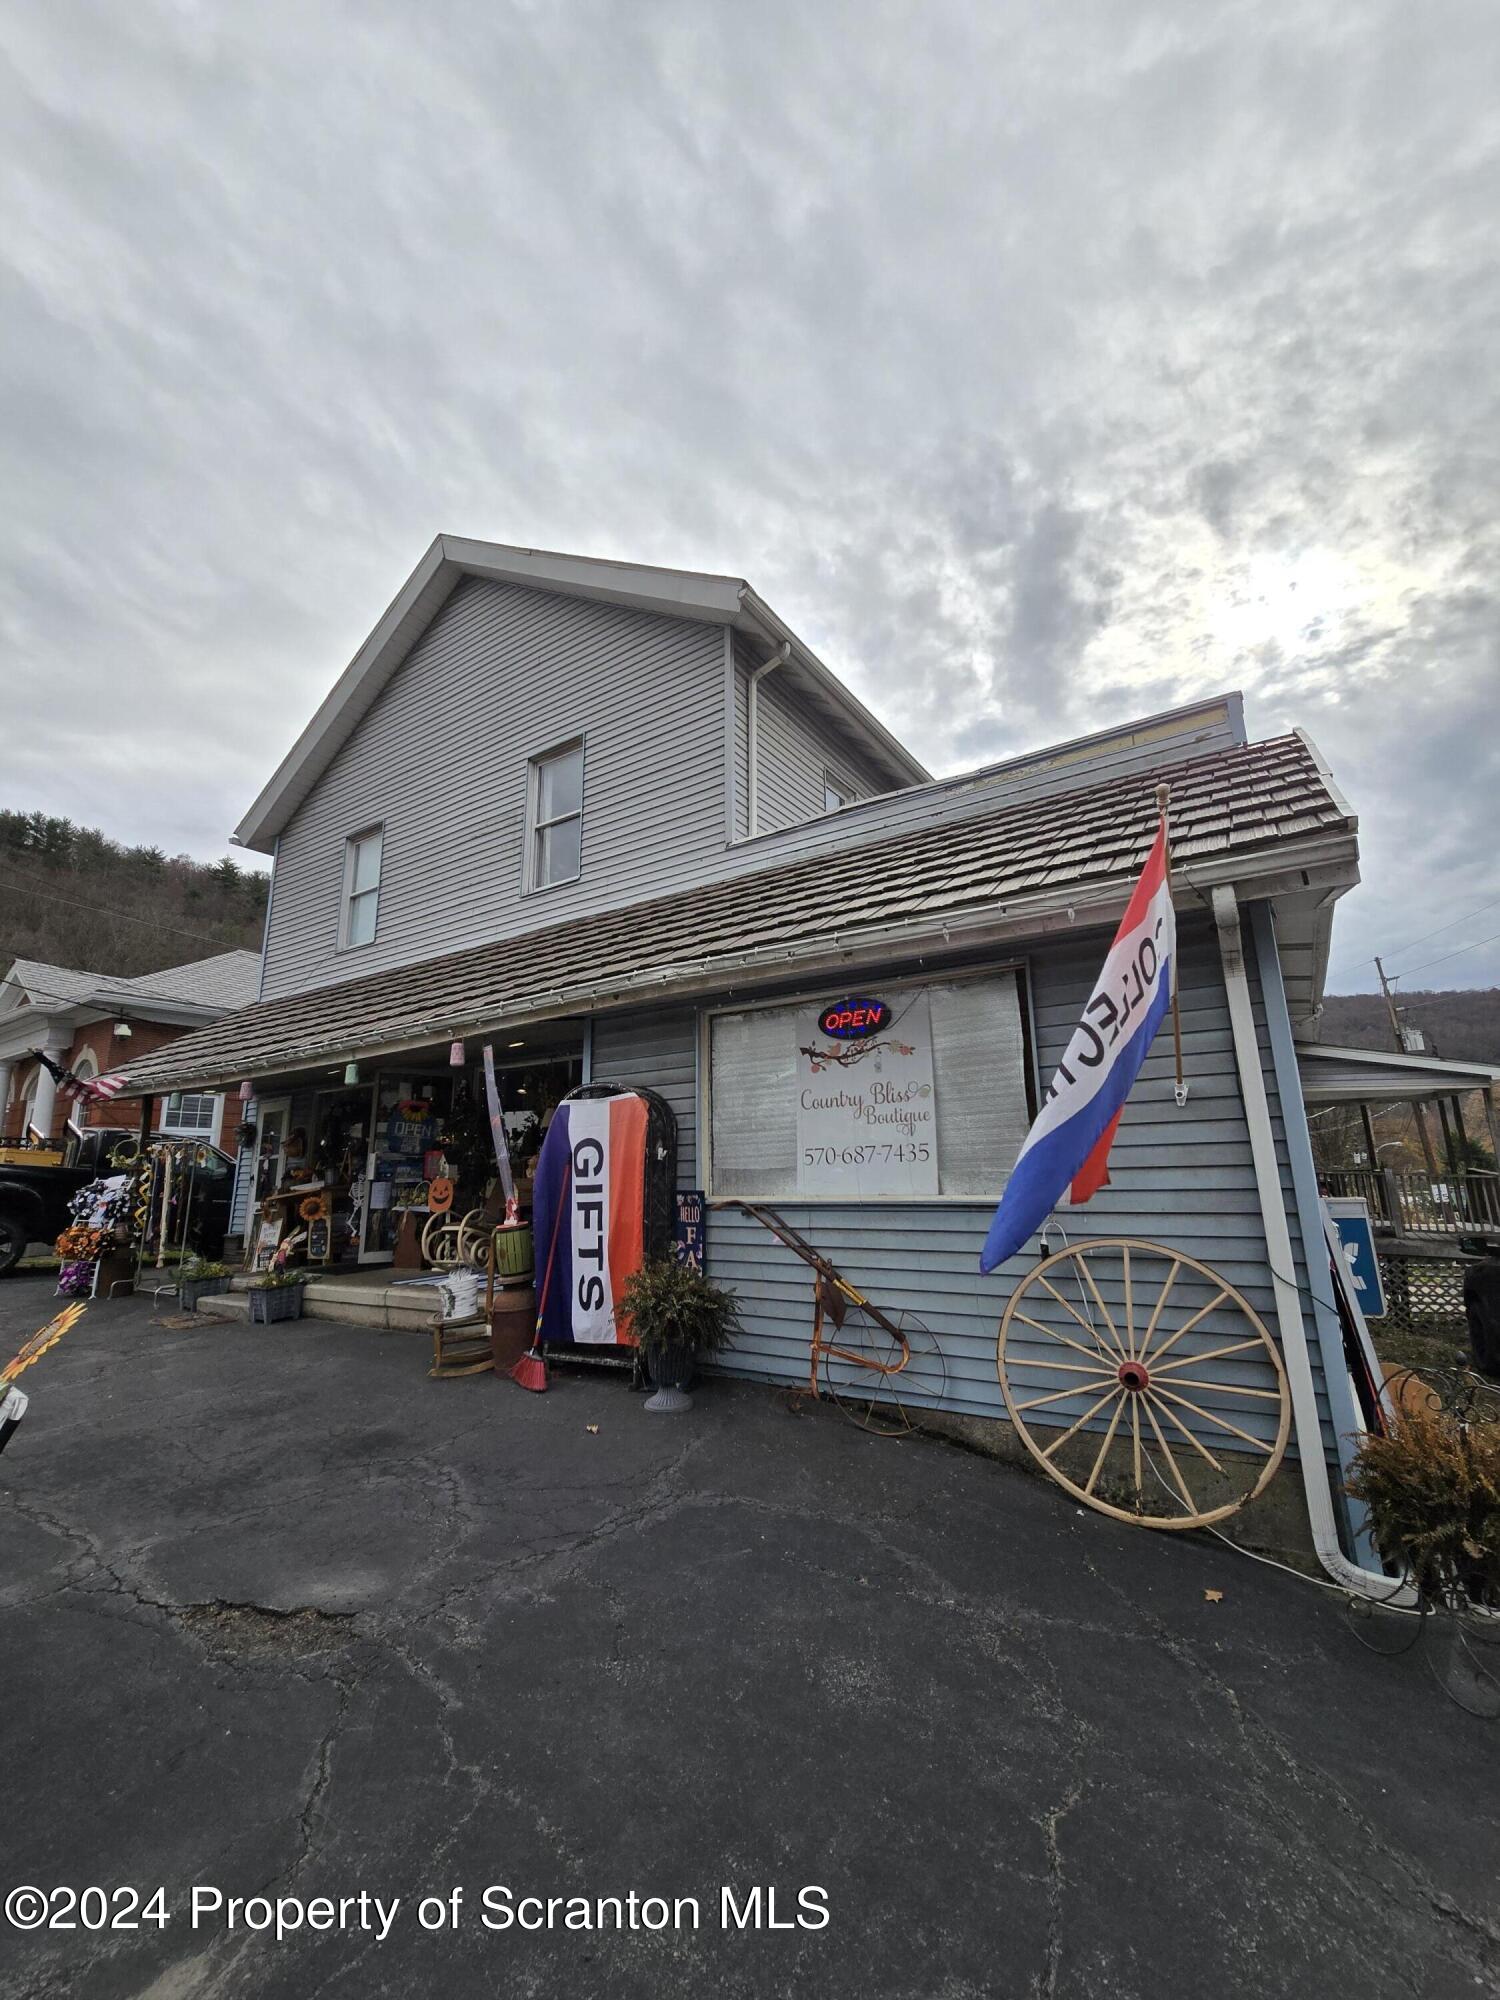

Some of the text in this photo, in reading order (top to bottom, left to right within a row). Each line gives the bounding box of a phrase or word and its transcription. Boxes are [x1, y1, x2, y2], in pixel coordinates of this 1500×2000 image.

[825, 1008, 883, 1029] OPEN
[801, 1081, 915, 1119] Country Bliss
[394, 1121, 432, 1137] OPEN
[863, 1105, 931, 1136] Boutique
[803, 1143, 930, 1166] 570-687-7435
[574, 1138, 604, 1311] GIFTS
[680, 1206, 700, 1223] HELLO
